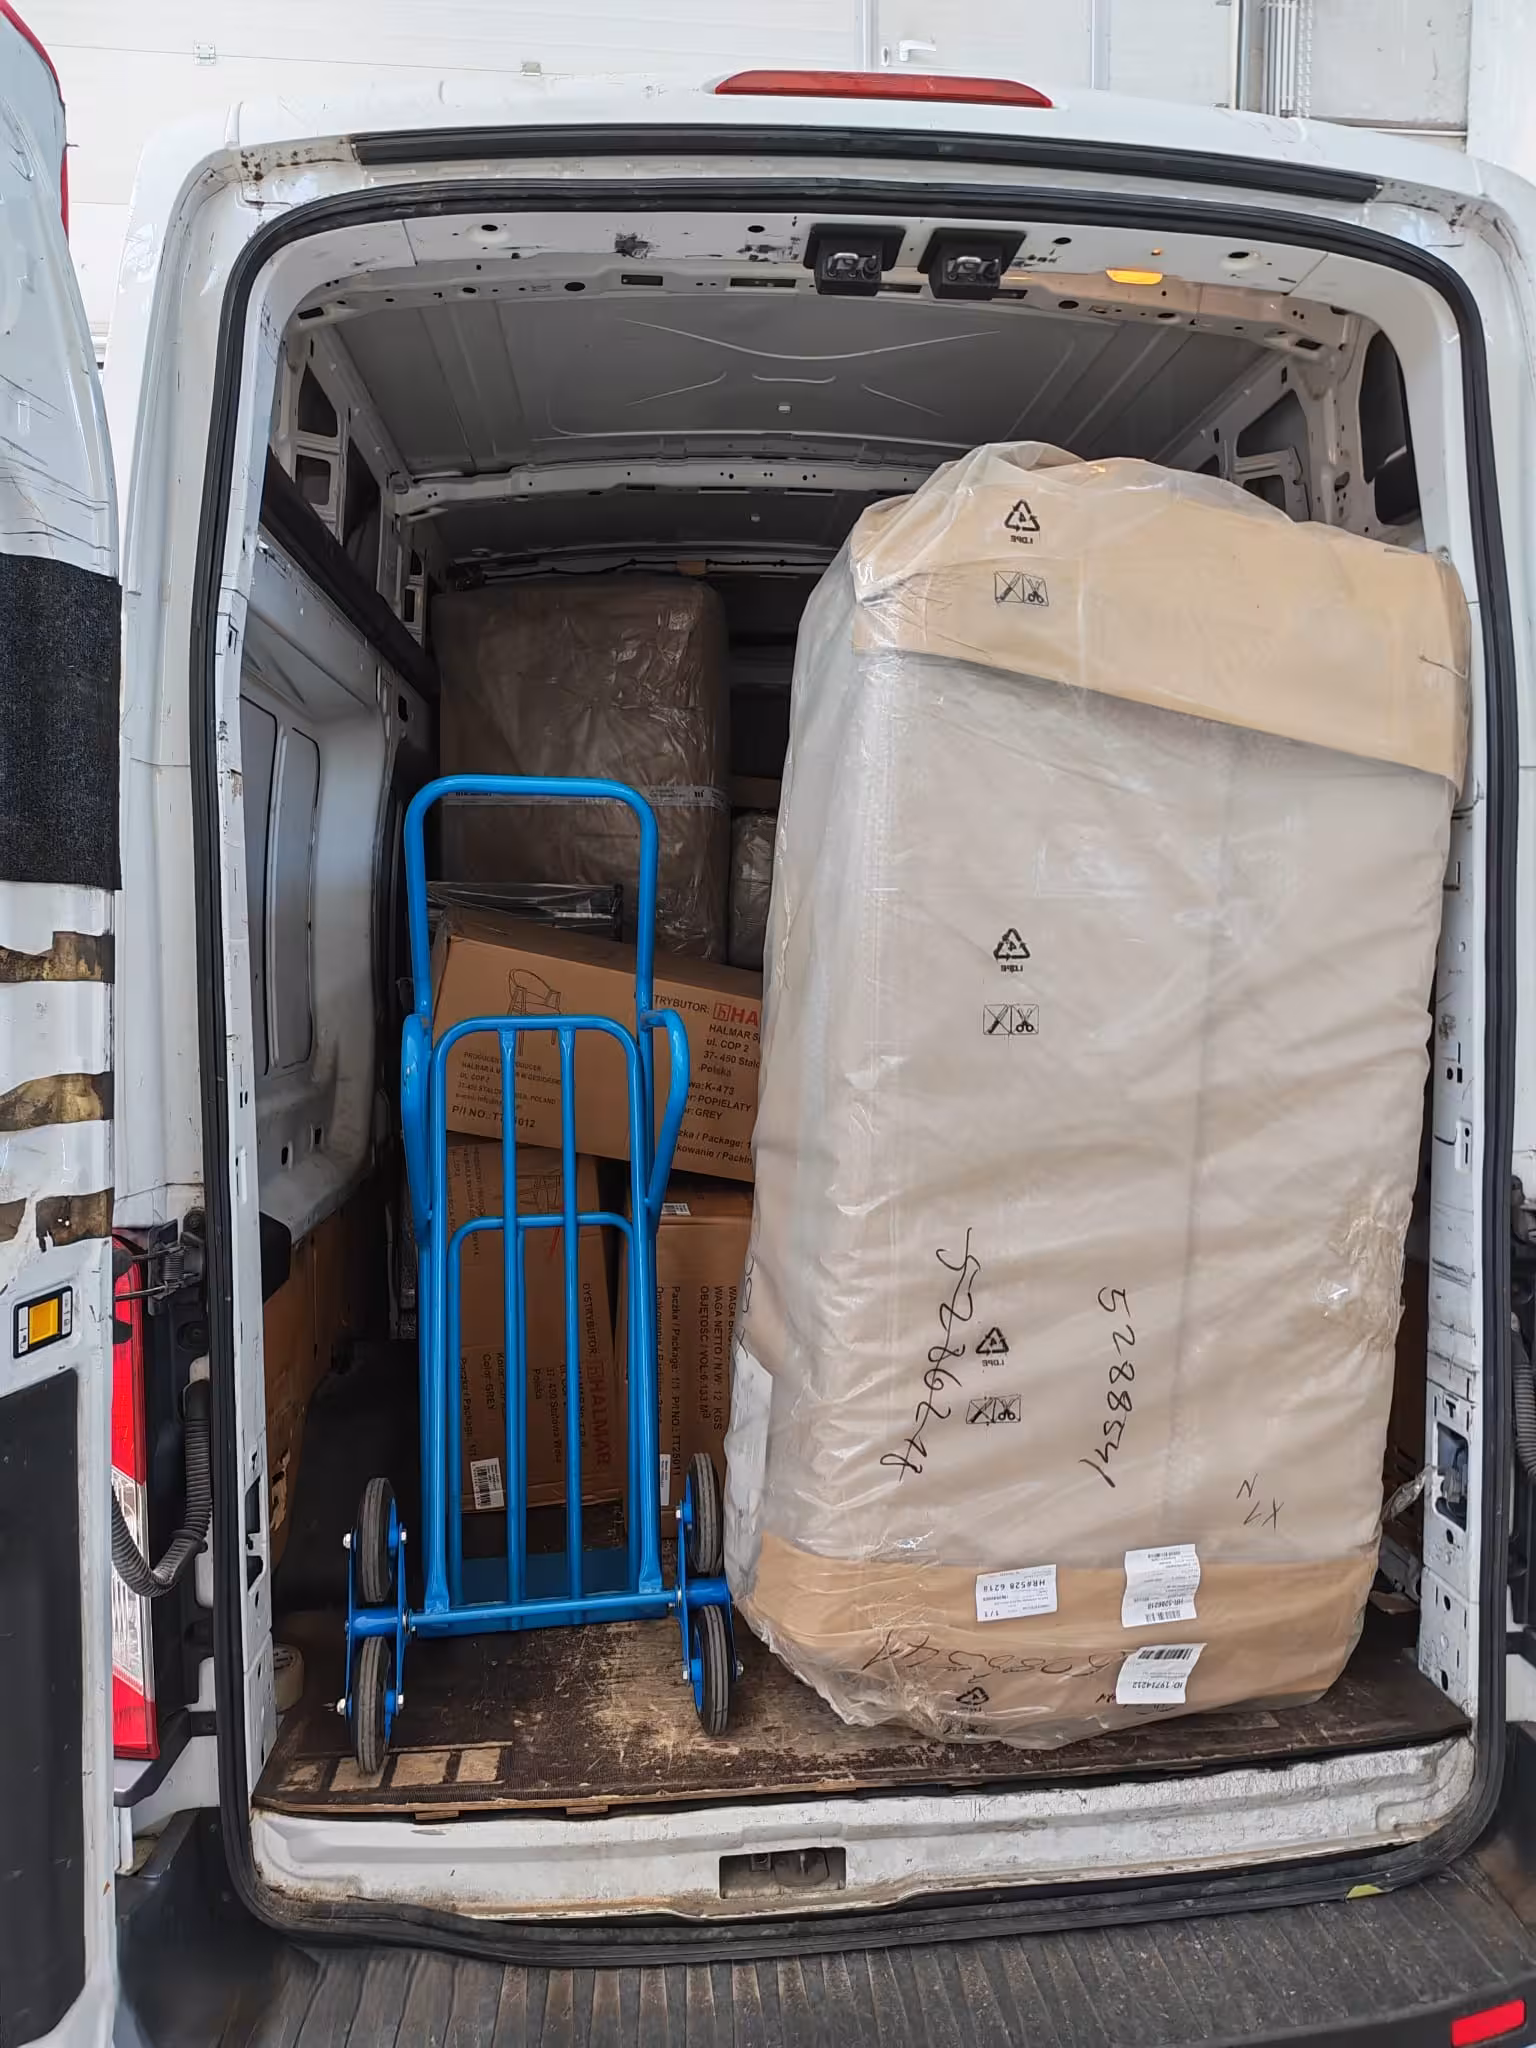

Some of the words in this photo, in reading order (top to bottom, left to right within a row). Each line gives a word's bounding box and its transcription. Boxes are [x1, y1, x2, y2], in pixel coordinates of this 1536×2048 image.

[654, 994, 710, 1014] TRYBUTOR:
[709, 1024, 750, 1040] HALMAR
[720, 1040, 742, 1051] COP
[743, 1044, 750, 1053] 2
[713, 1286, 723, 1317] WAGA
[713, 1320, 723, 1354] NETTO
[714, 1407, 722, 1431] KGS
